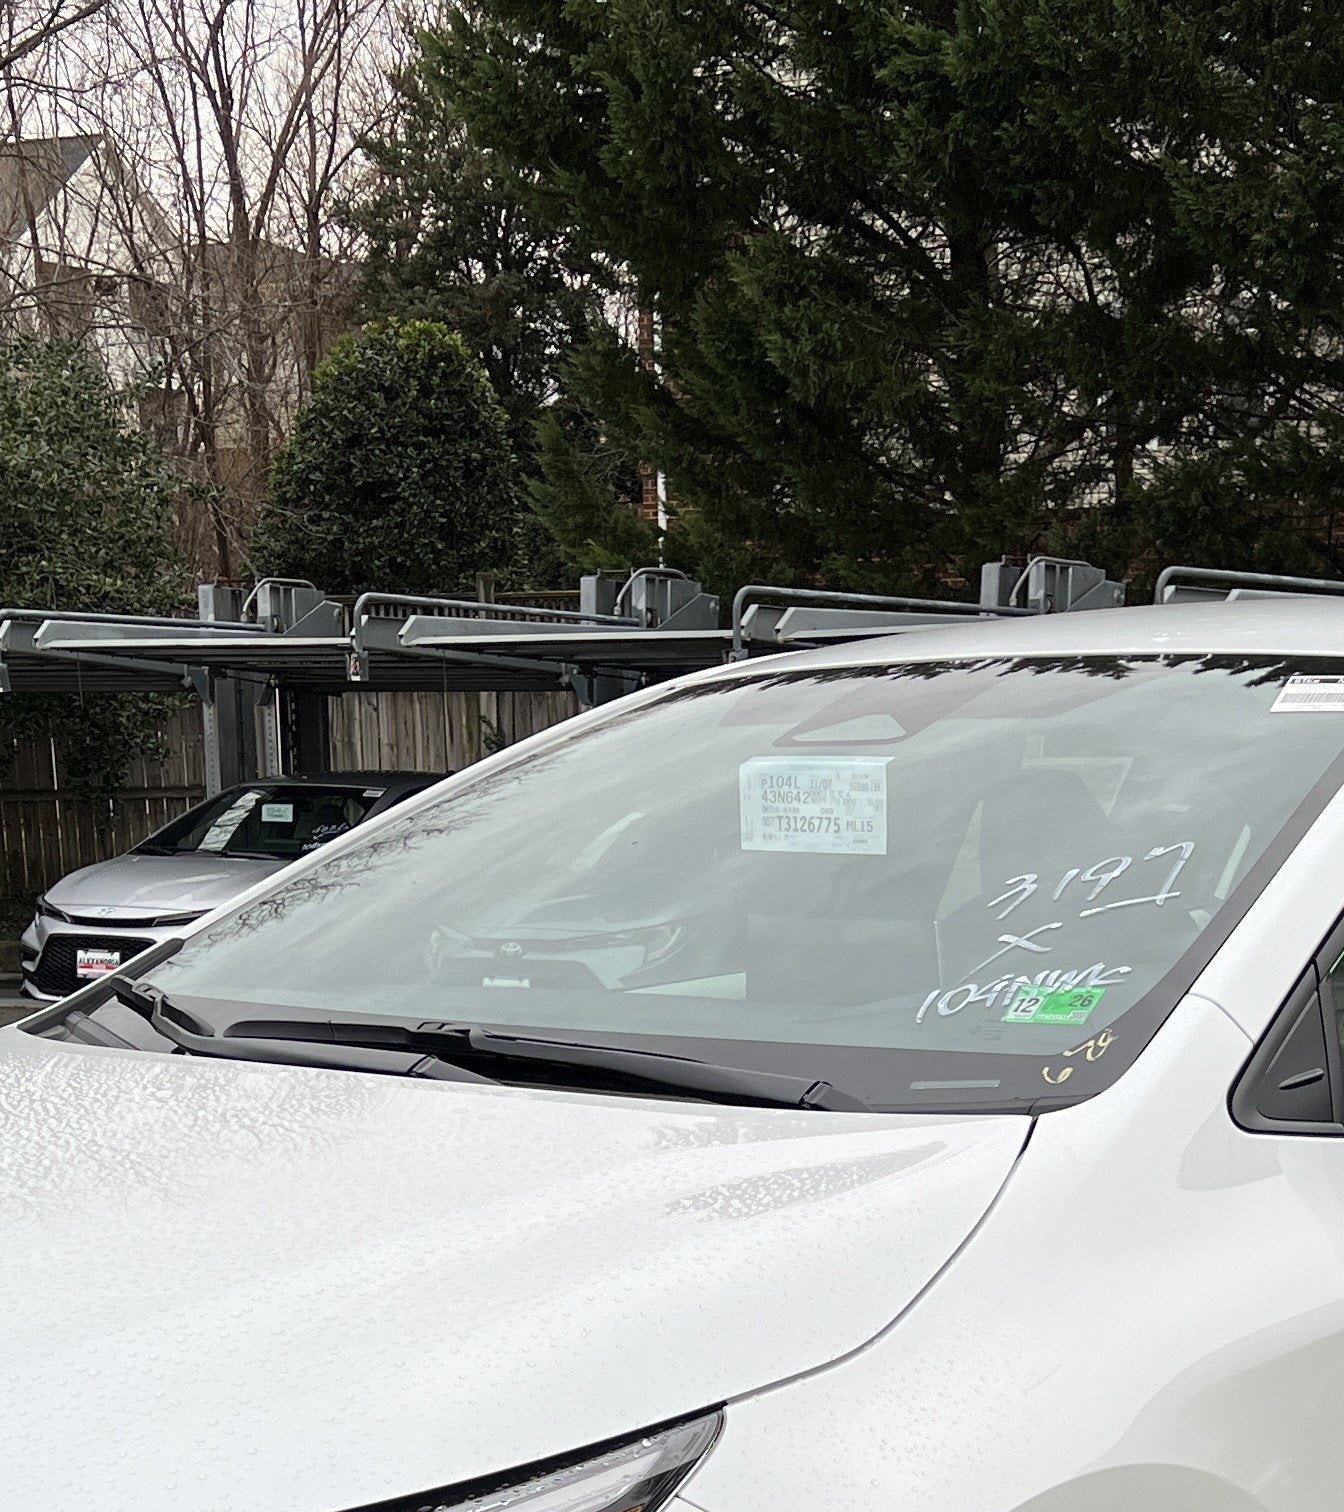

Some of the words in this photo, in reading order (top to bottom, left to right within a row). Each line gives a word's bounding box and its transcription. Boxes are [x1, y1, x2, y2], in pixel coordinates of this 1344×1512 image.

[777, 816, 841, 833] T3126775
[1013, 997, 1041, 1013] 12
[1069, 994, 1094, 1008] 26
